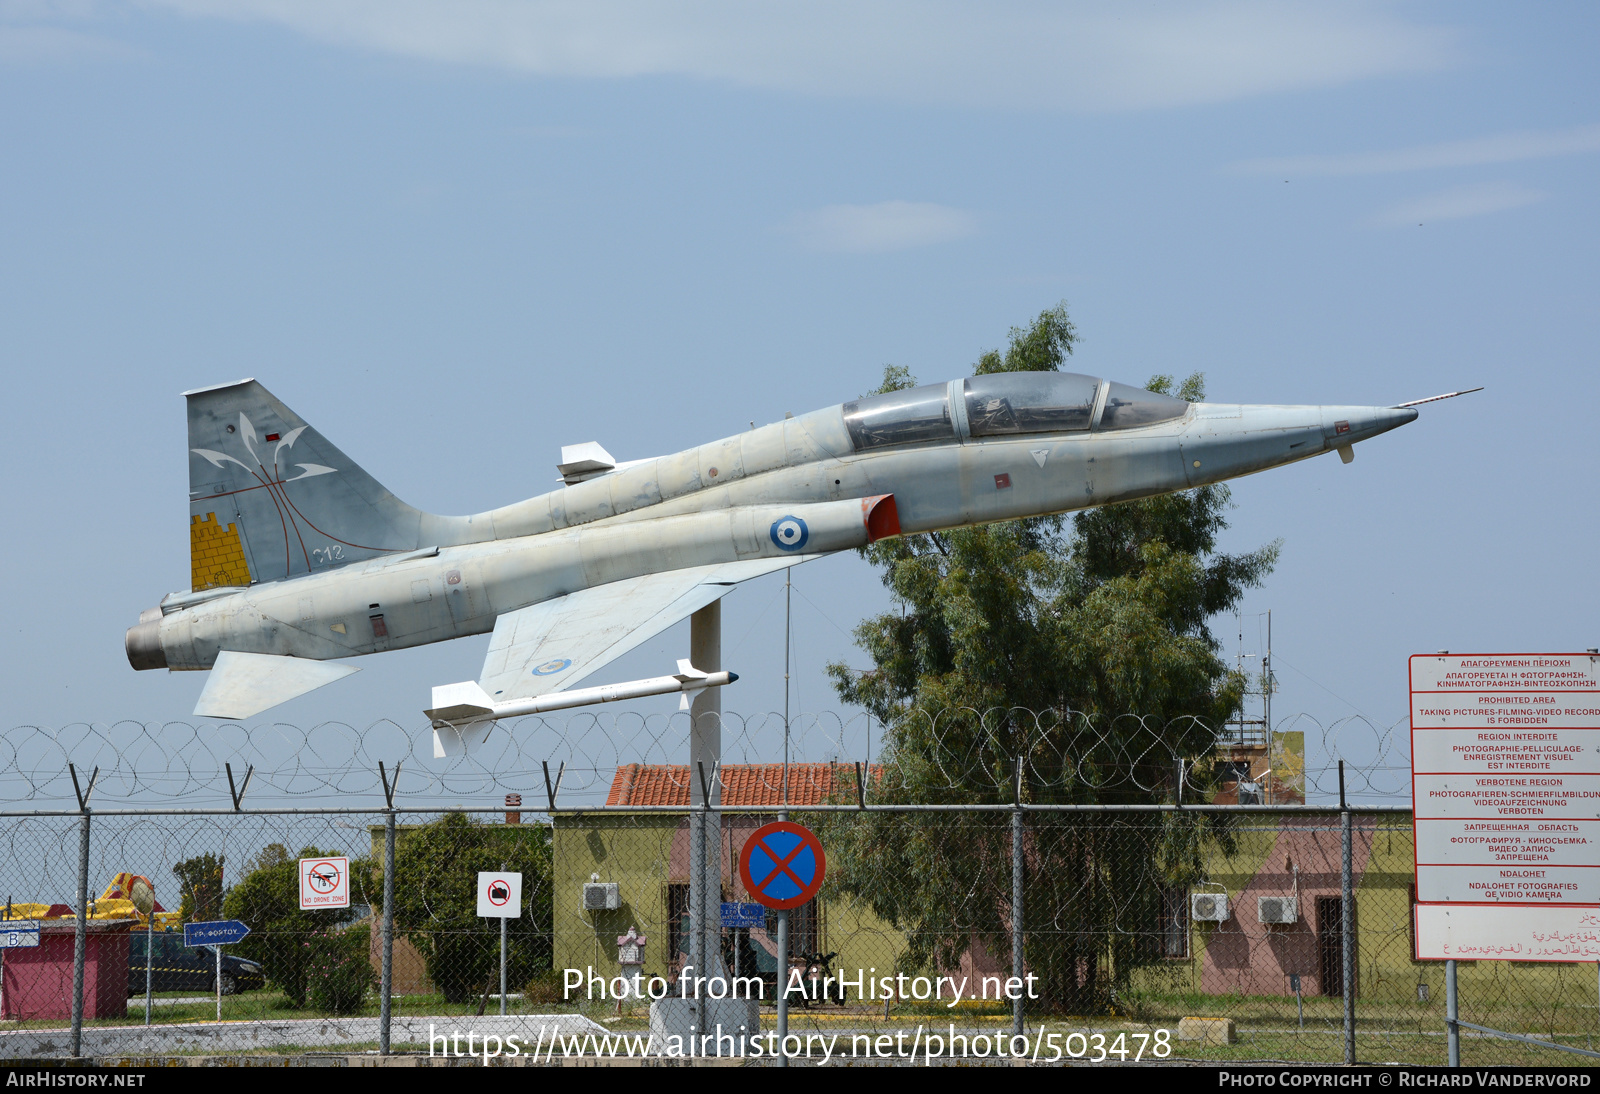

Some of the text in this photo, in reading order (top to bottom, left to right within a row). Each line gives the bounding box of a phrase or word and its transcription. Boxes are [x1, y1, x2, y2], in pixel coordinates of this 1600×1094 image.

[1460, 659, 1571, 668] ΑΠΑΓΟΡΕΥΜΕΝΗ ΠΕΡΙΟΧΗ
[1478, 696, 1556, 704] PROHIBITED AREA
[1419, 708, 1451, 716] TAKING
[1453, 708, 1562, 716] PICTURES-FILMING-VIDEO
[1487, 716, 1548, 724] IS FORBIDDEN
[1477, 733, 1558, 741] REGION INTERDITE
[1452, 745, 1584, 753] PHOTOGRAPHIE-PELLICULAGE-
[1463, 753, 1574, 761] ENREGISTREMENT VISUEL
[1487, 762, 1551, 770] EST INTERDITE
[1475, 778, 1563, 786] VERBOTENE REGION
[1473, 799, 1567, 807] VIDEOAUFZEICHNUNG
[1498, 807, 1544, 815] VERBOTEN
[1464, 823, 1579, 832] ЗАПРЕЩЕННАЯ ОБЛАСТЬ
[1450, 836, 1521, 844] ФОТОГРАФИРУЯ
[1528, 837, 1587, 845] КИНОСЪЕМКА
[1488, 845, 1556, 853] ВИДЕО ЗАПИСЬ
[1495, 853, 1549, 862] ЗАПРЕЩЕНА
[1499, 870, 1546, 878] NDALOHET
[1468, 882, 1578, 891] NDALOHET FOTOGRAFIES
[1485, 890, 1563, 899] QE VIDIO KAMERA
